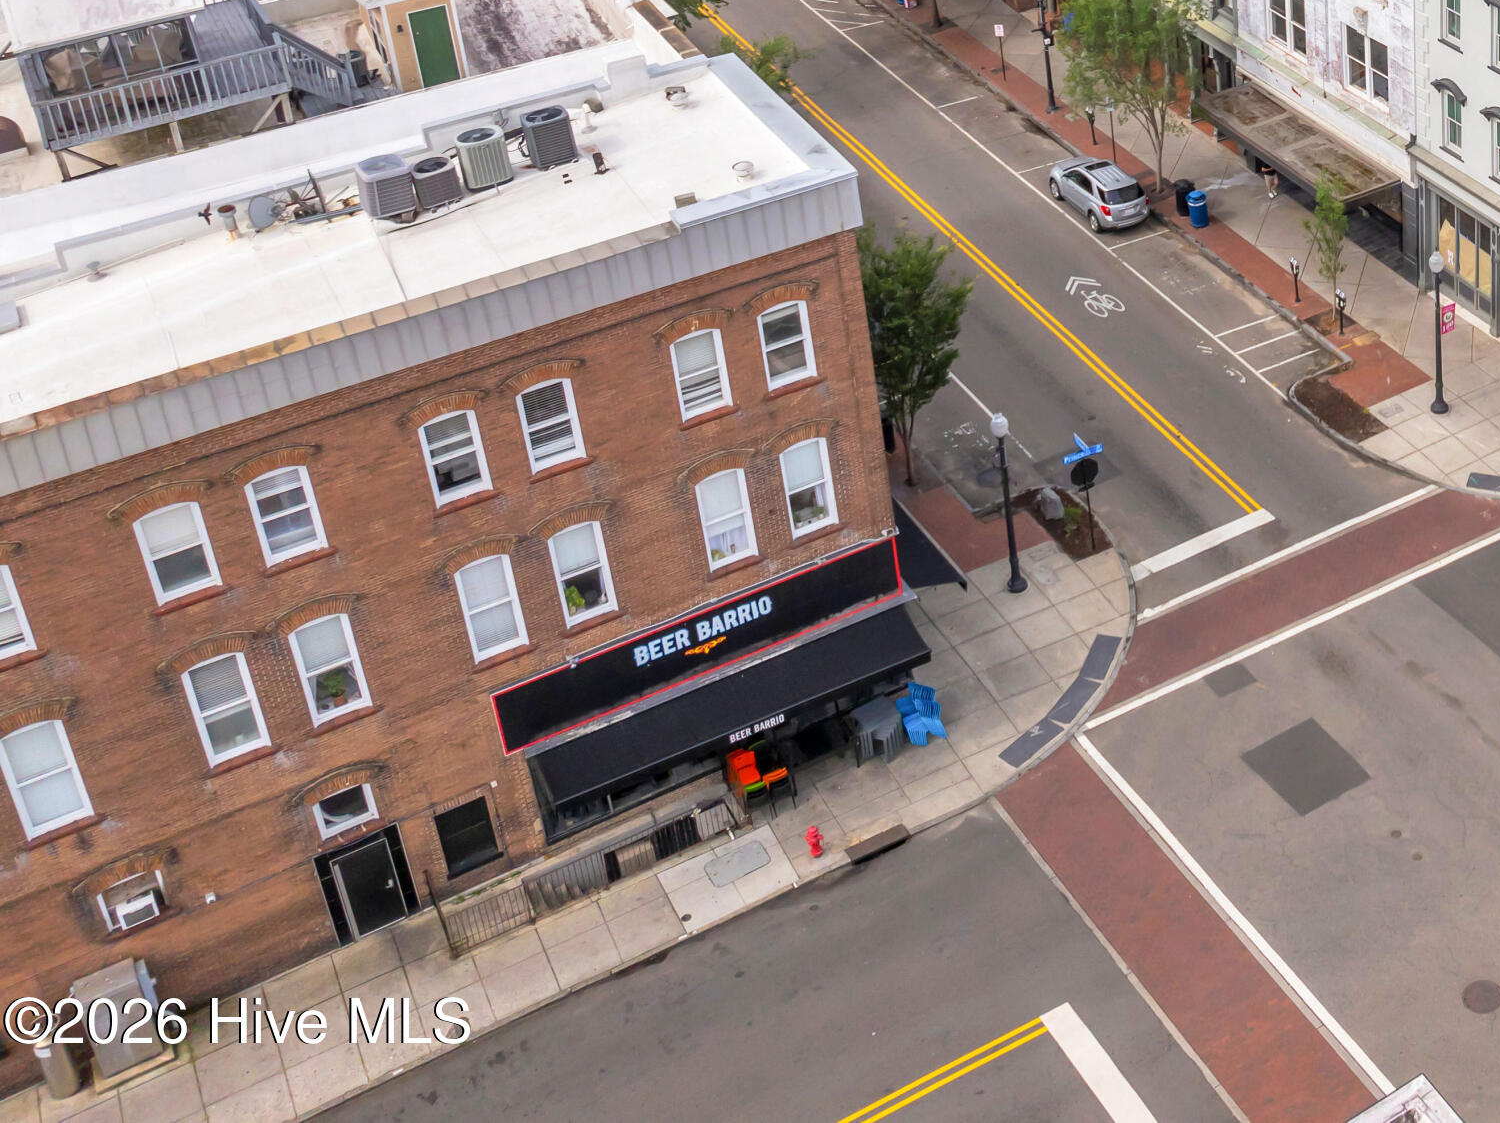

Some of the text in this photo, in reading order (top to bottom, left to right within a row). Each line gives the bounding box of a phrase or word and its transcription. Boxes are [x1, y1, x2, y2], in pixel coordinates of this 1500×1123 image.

[633, 594, 773, 668] BEER BARRIO
[729, 713, 785, 744] BEER BARRIO
